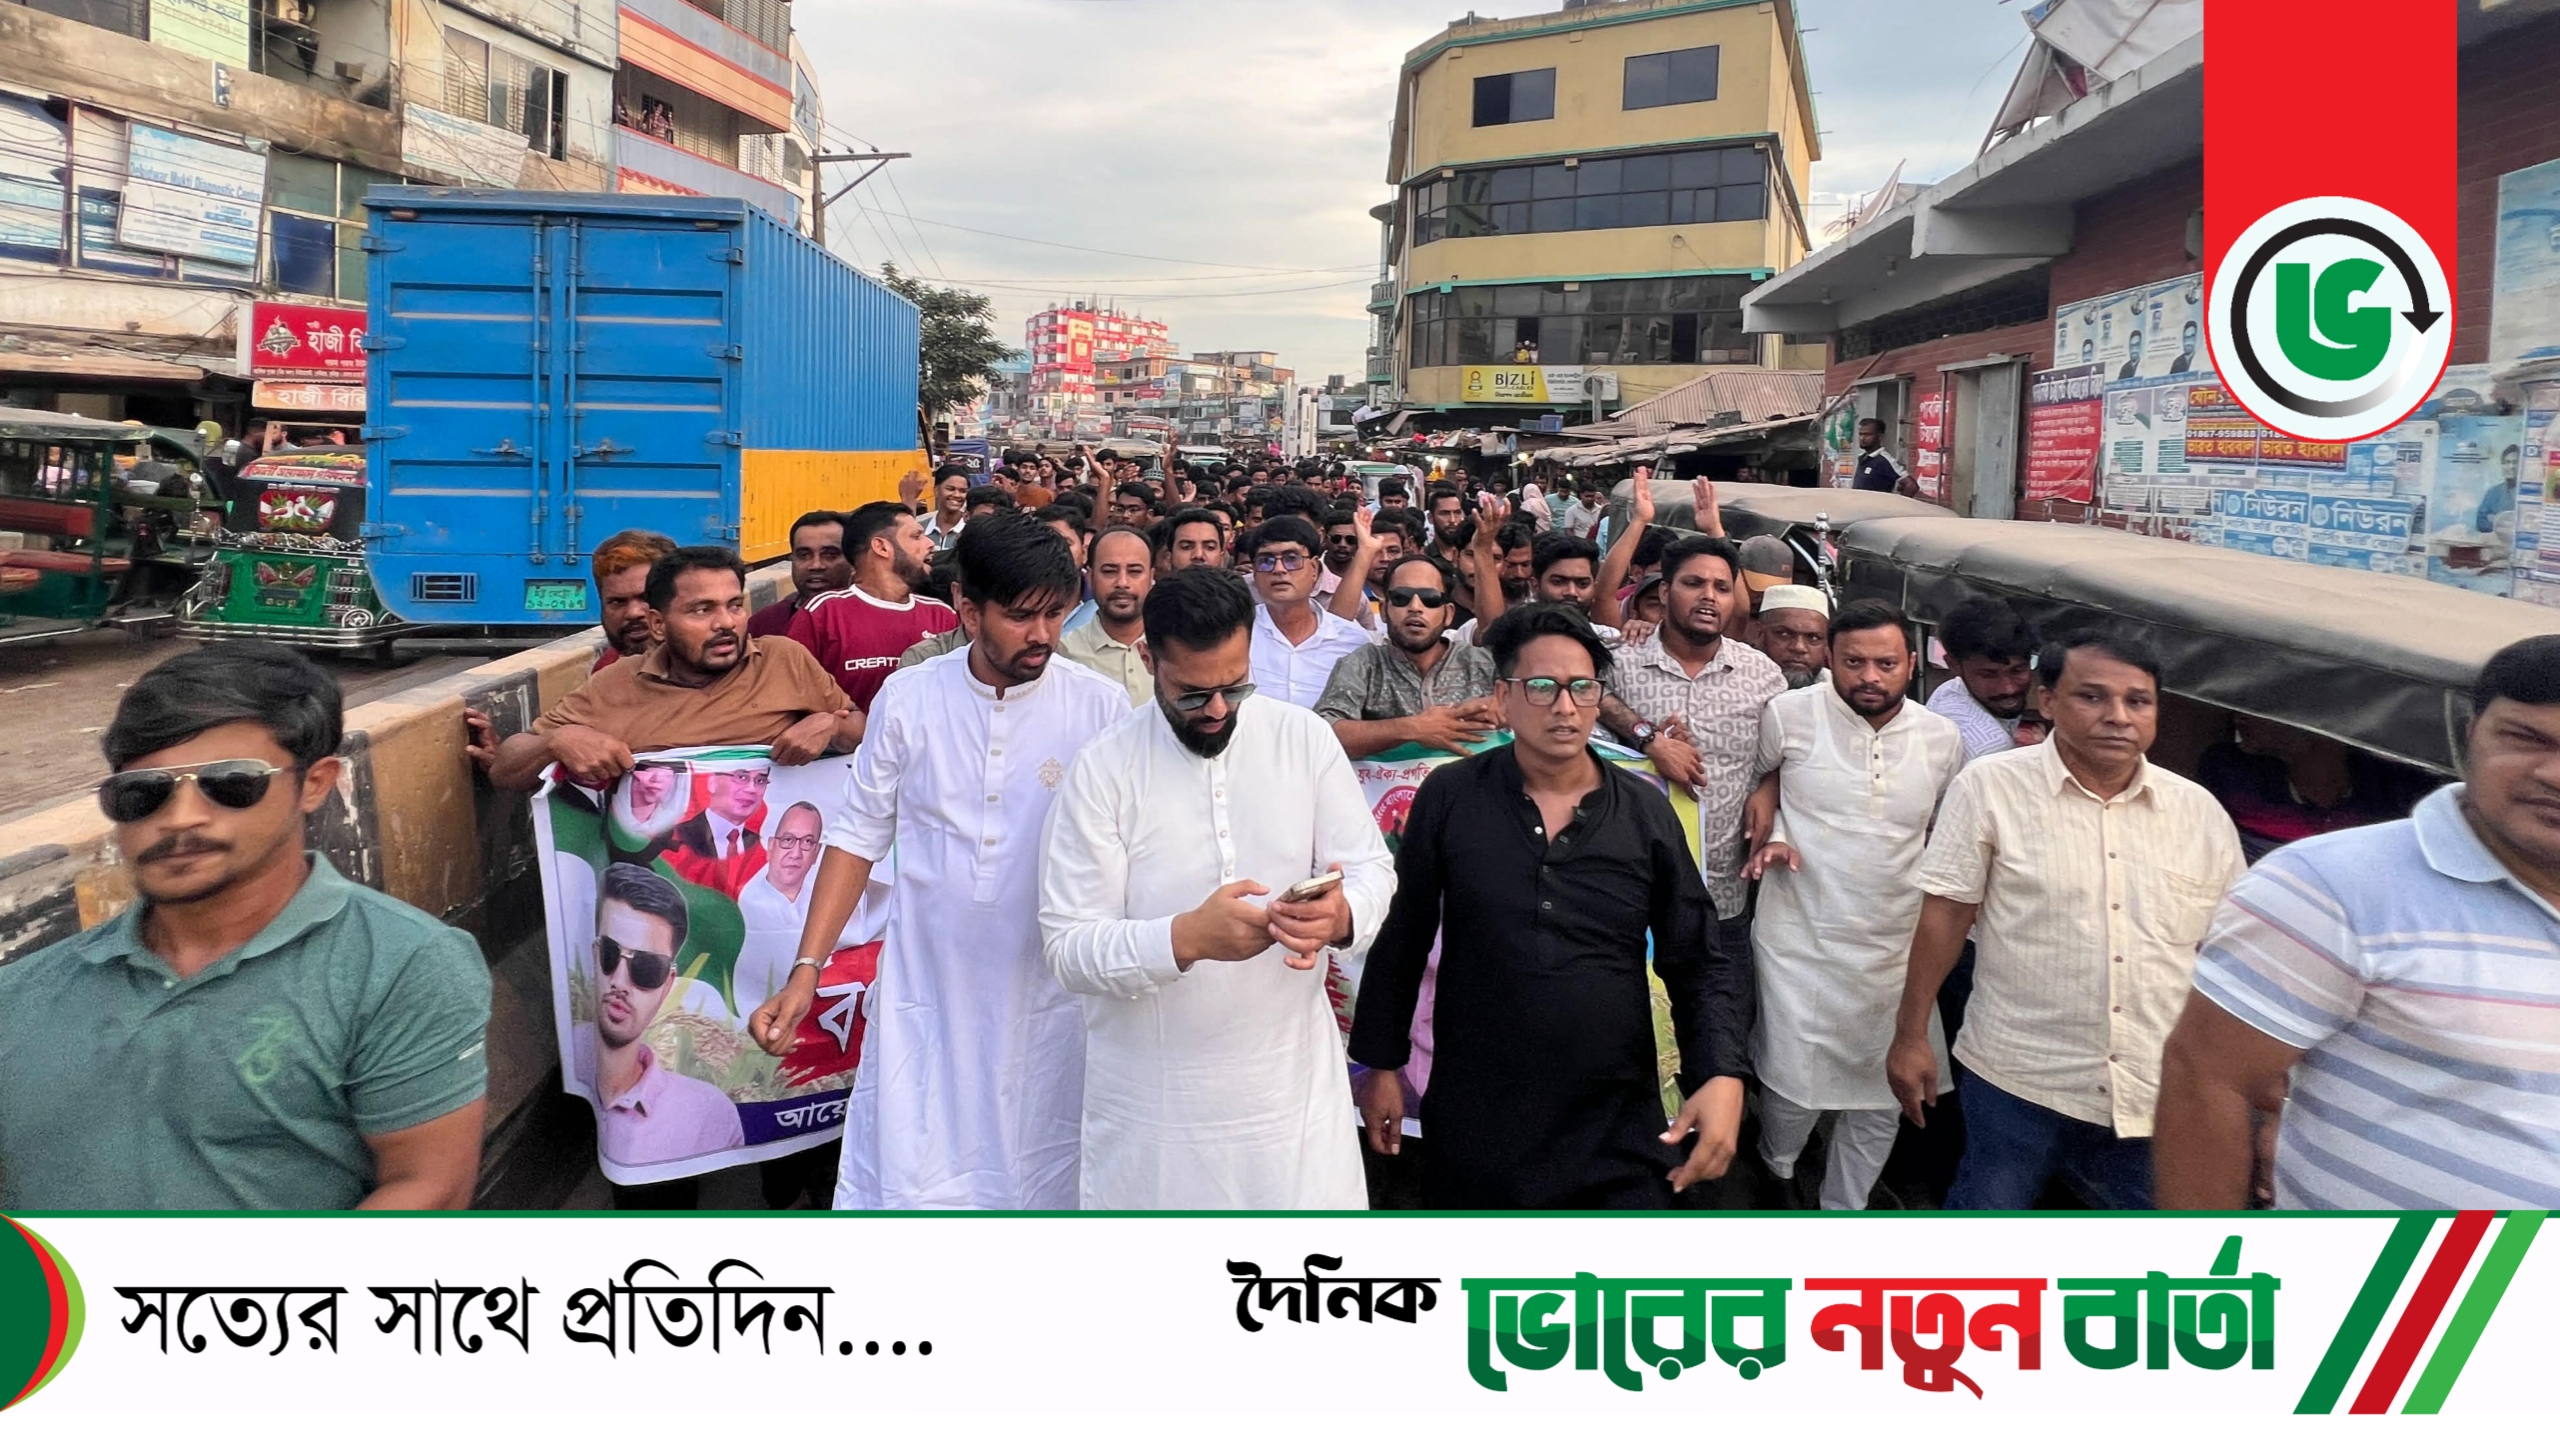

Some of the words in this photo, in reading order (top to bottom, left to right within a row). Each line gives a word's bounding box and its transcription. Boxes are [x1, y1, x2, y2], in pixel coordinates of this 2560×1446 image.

[306, 325, 345, 355] হাজী
[349, 327, 367, 354] বি
[275, 386, 325, 406] হাজী
[2187, 440, 2214, 454] ভারত
[2217, 440, 2255, 457] হারবাল
[2261, 441, 2293, 456] ভারত
[2298, 443, 2344, 461] হারবাল
[2241, 491, 2307, 523] নিউরন
[2330, 500, 2412, 535] নিউরন
[816, 981, 875, 1054] ব
